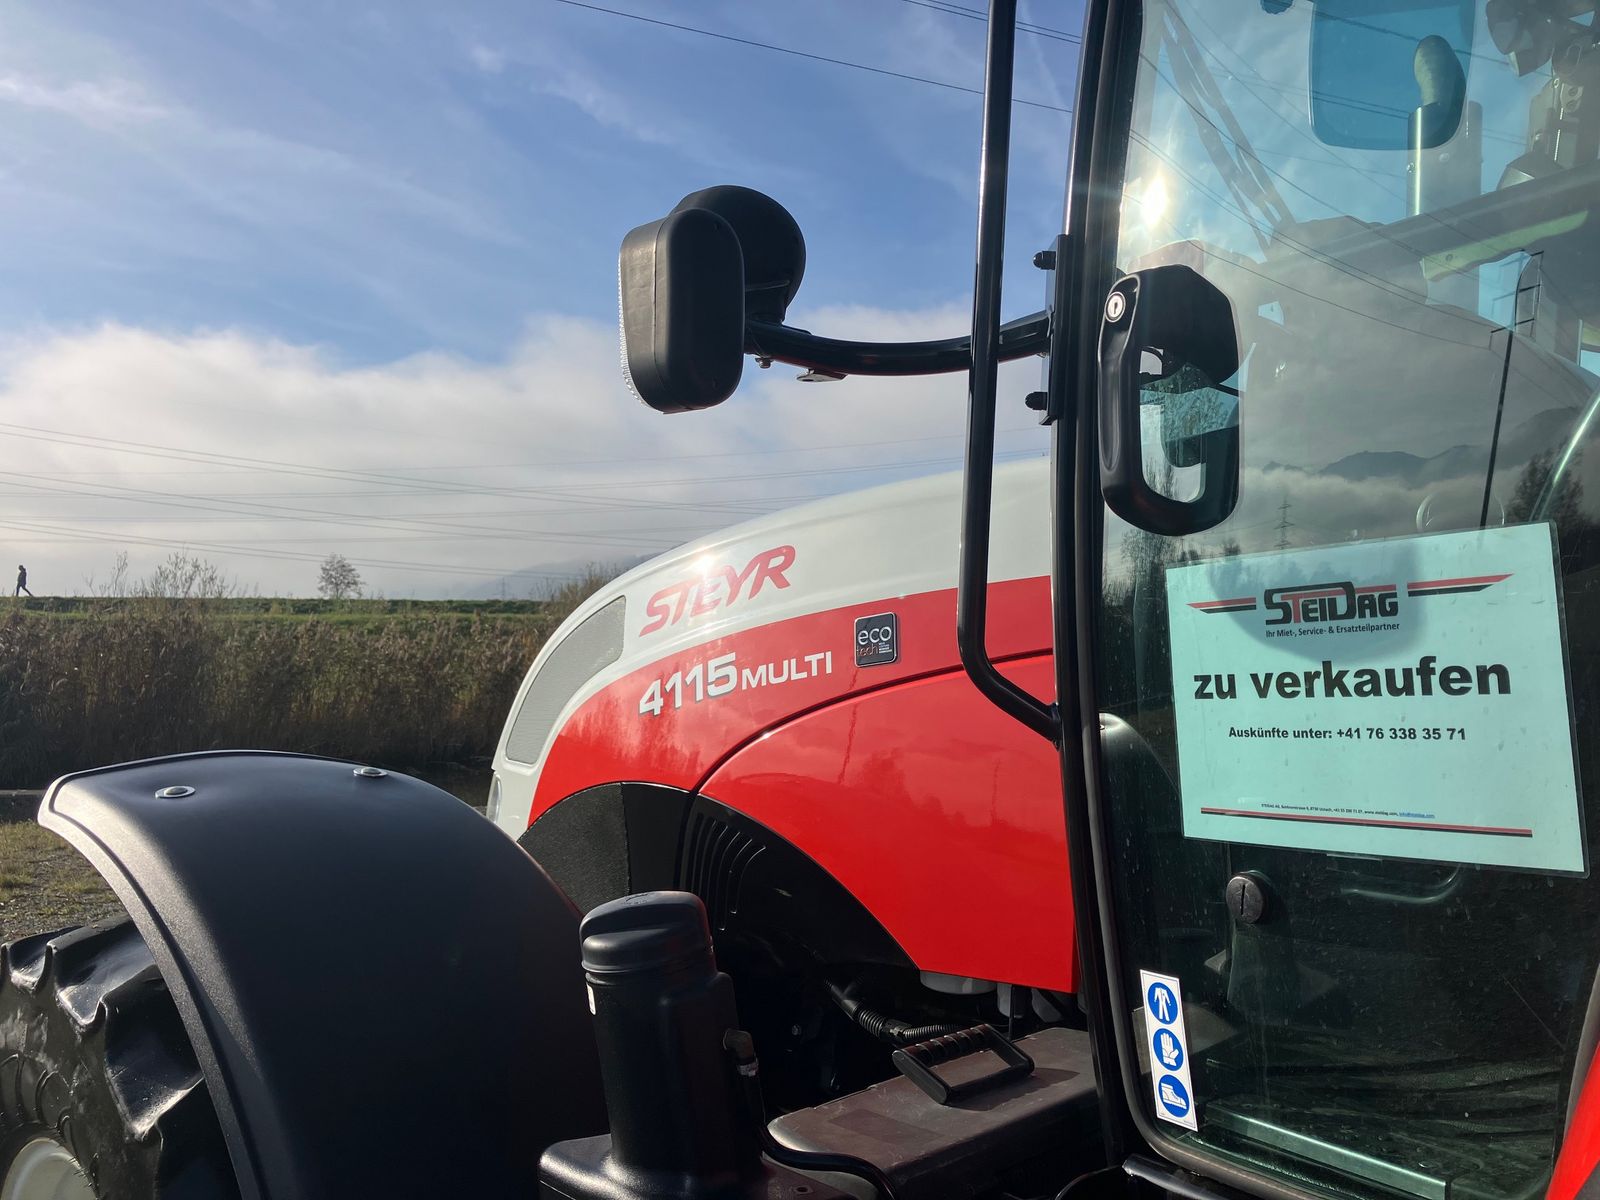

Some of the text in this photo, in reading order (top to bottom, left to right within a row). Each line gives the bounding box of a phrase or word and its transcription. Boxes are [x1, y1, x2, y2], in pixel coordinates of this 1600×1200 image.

[639, 545, 796, 637] STEYR
[858, 626, 892, 645] eco
[1266, 630, 1275, 638] Ihr
[1277, 629, 1297, 637] Miet-,
[1298, 626, 1326, 636] Service-
[1336, 623, 1400, 634] Ersatzteilpartner
[639, 651, 832, 716] 4115 MULTI
[1194, 656, 1511, 699] zu verkaufen
[1229, 727, 1466, 740] Auskünfte unter: +41 76 338 35 71
